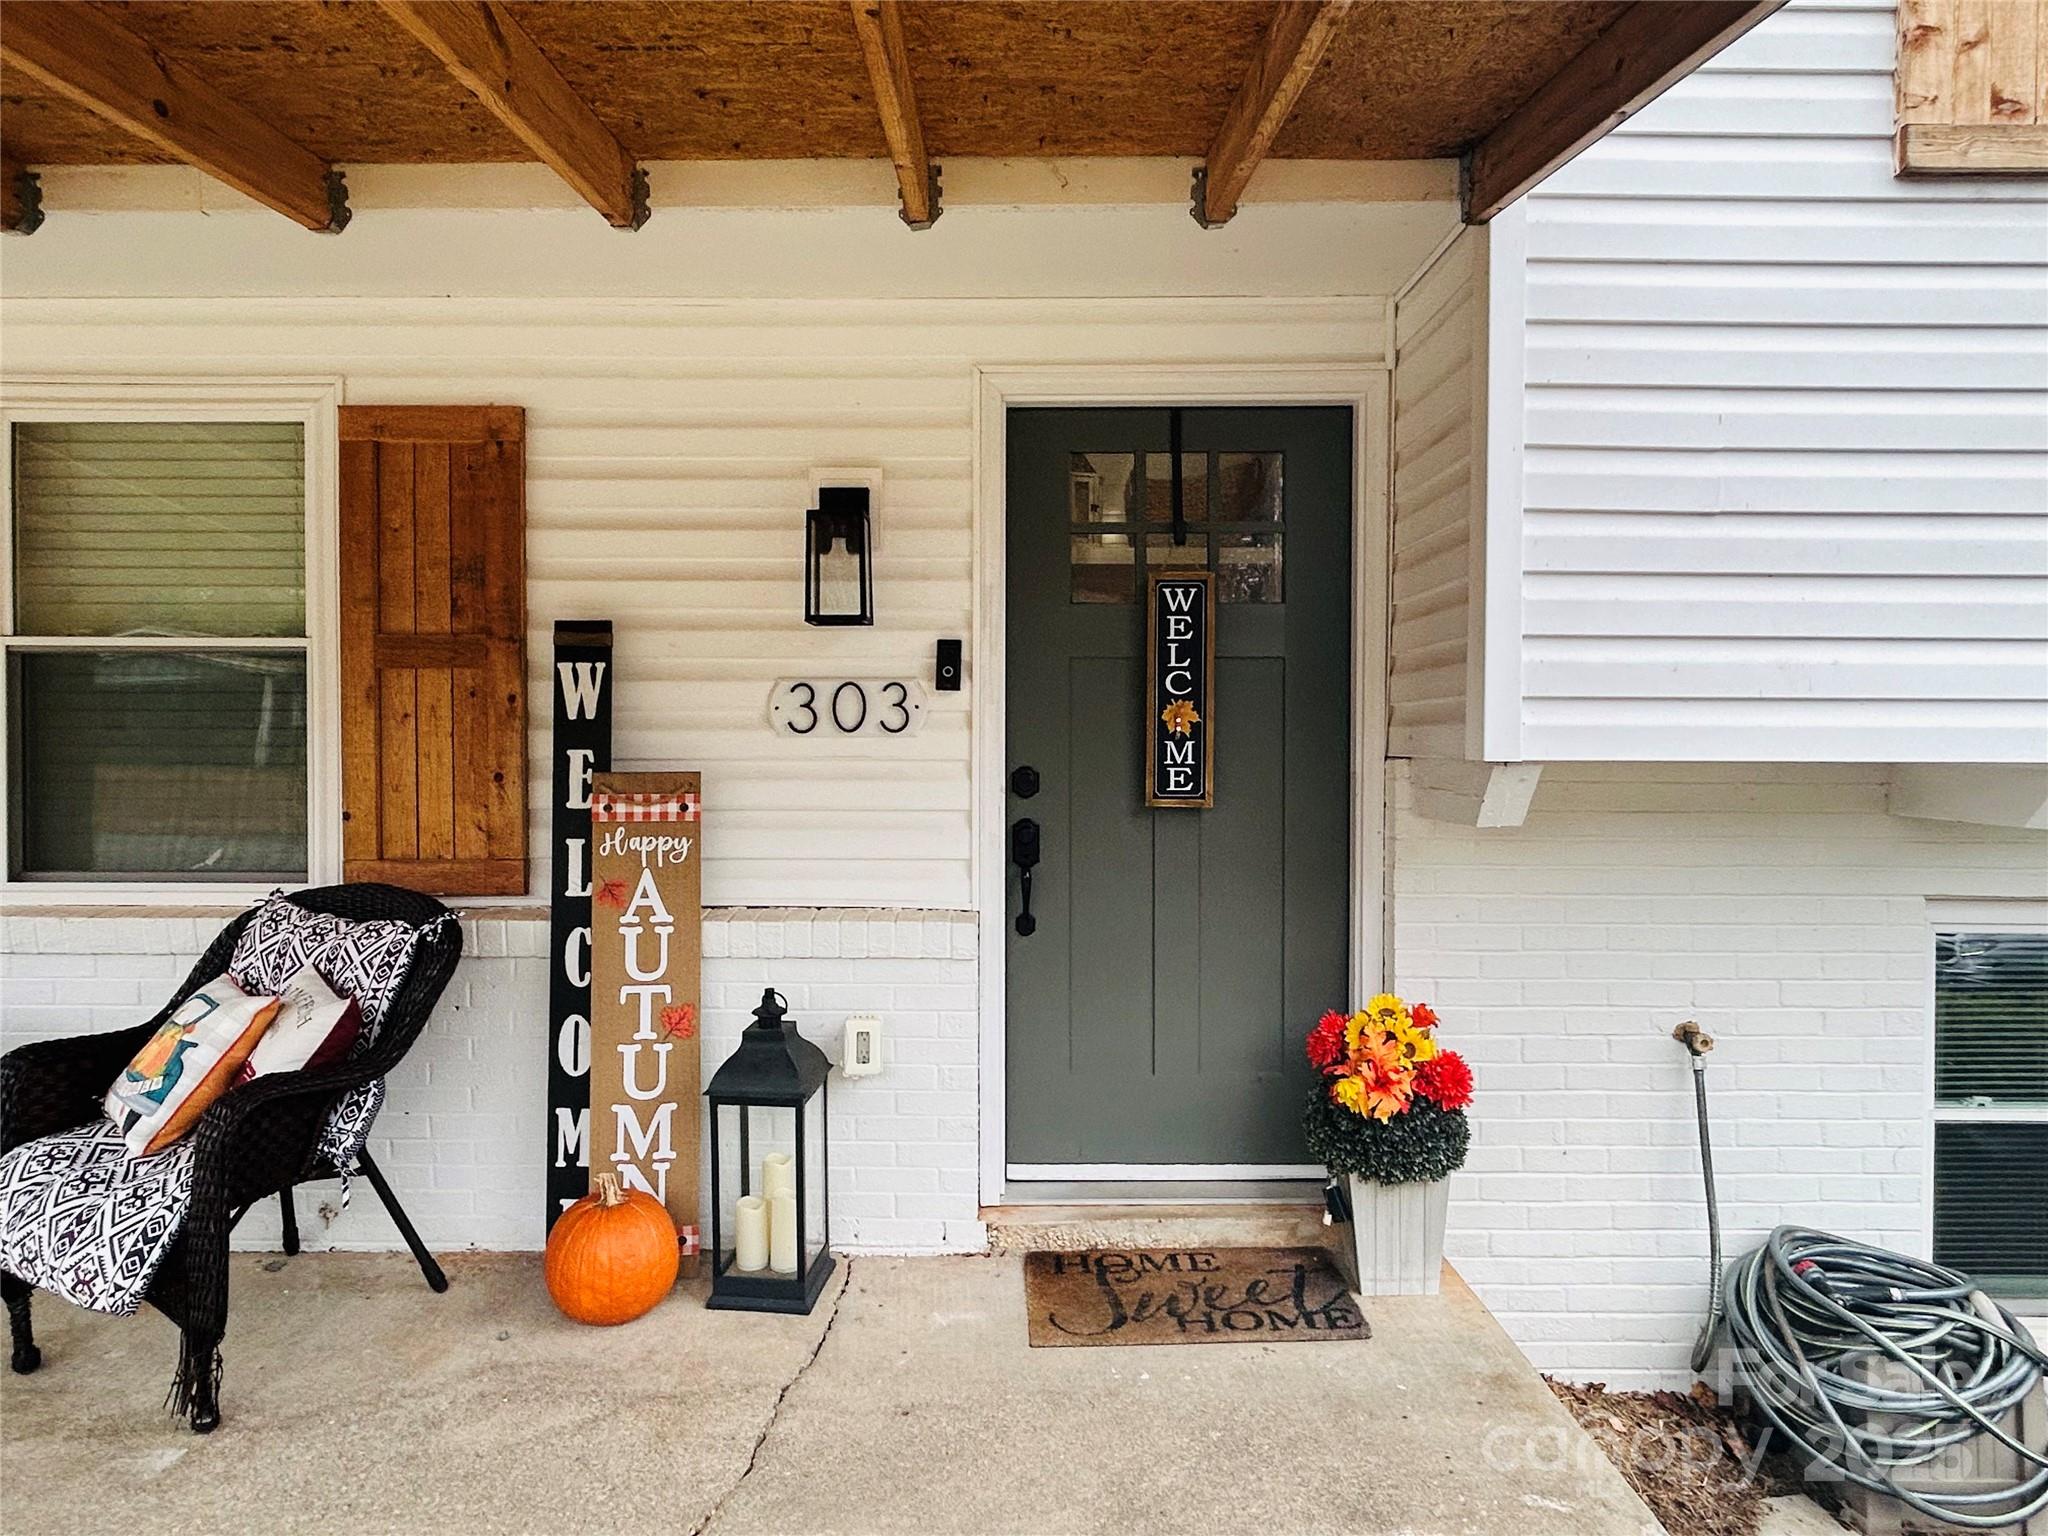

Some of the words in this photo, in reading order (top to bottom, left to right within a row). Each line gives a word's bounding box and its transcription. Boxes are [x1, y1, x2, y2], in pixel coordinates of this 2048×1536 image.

[788, 681, 910, 734] 303
[599, 826, 692, 868] Happy
[555, 661, 606, 1211] WELCOM
[1053, 1252, 1221, 1275] HOME
[1050, 1254, 1352, 1336] Sweet
[1177, 1308, 1362, 1333] HOME
